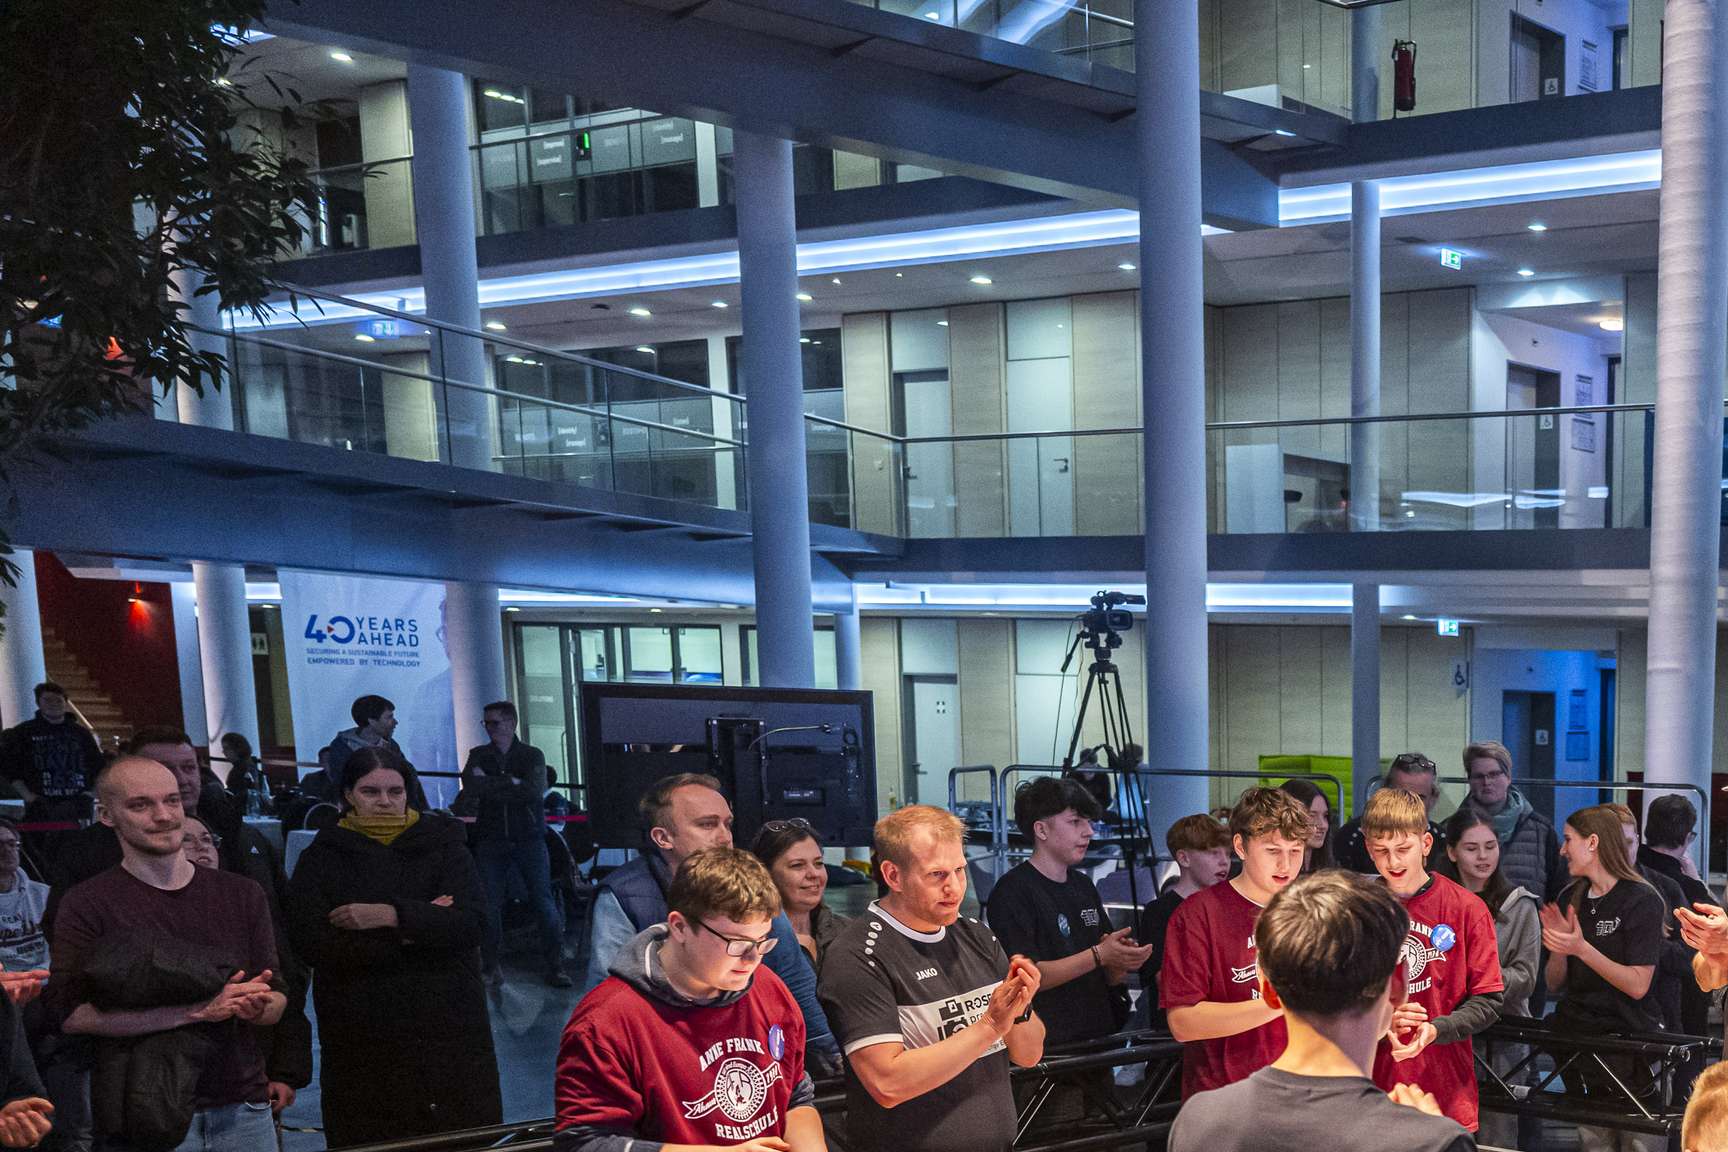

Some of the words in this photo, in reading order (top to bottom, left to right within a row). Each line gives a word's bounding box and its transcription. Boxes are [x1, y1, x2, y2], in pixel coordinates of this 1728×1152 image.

[304, 614, 355, 644] 40
[355, 616, 419, 632] YEARS
[357, 632, 420, 647] AHEAD
[307, 657, 355, 665] EMPOWERED
[373, 659, 421, 667] TECHNOLOGY
[916, 967, 938, 981] JAKO
[699, 1041, 724, 1072] ANNE
[726, 1037, 765, 1055] FRANK
